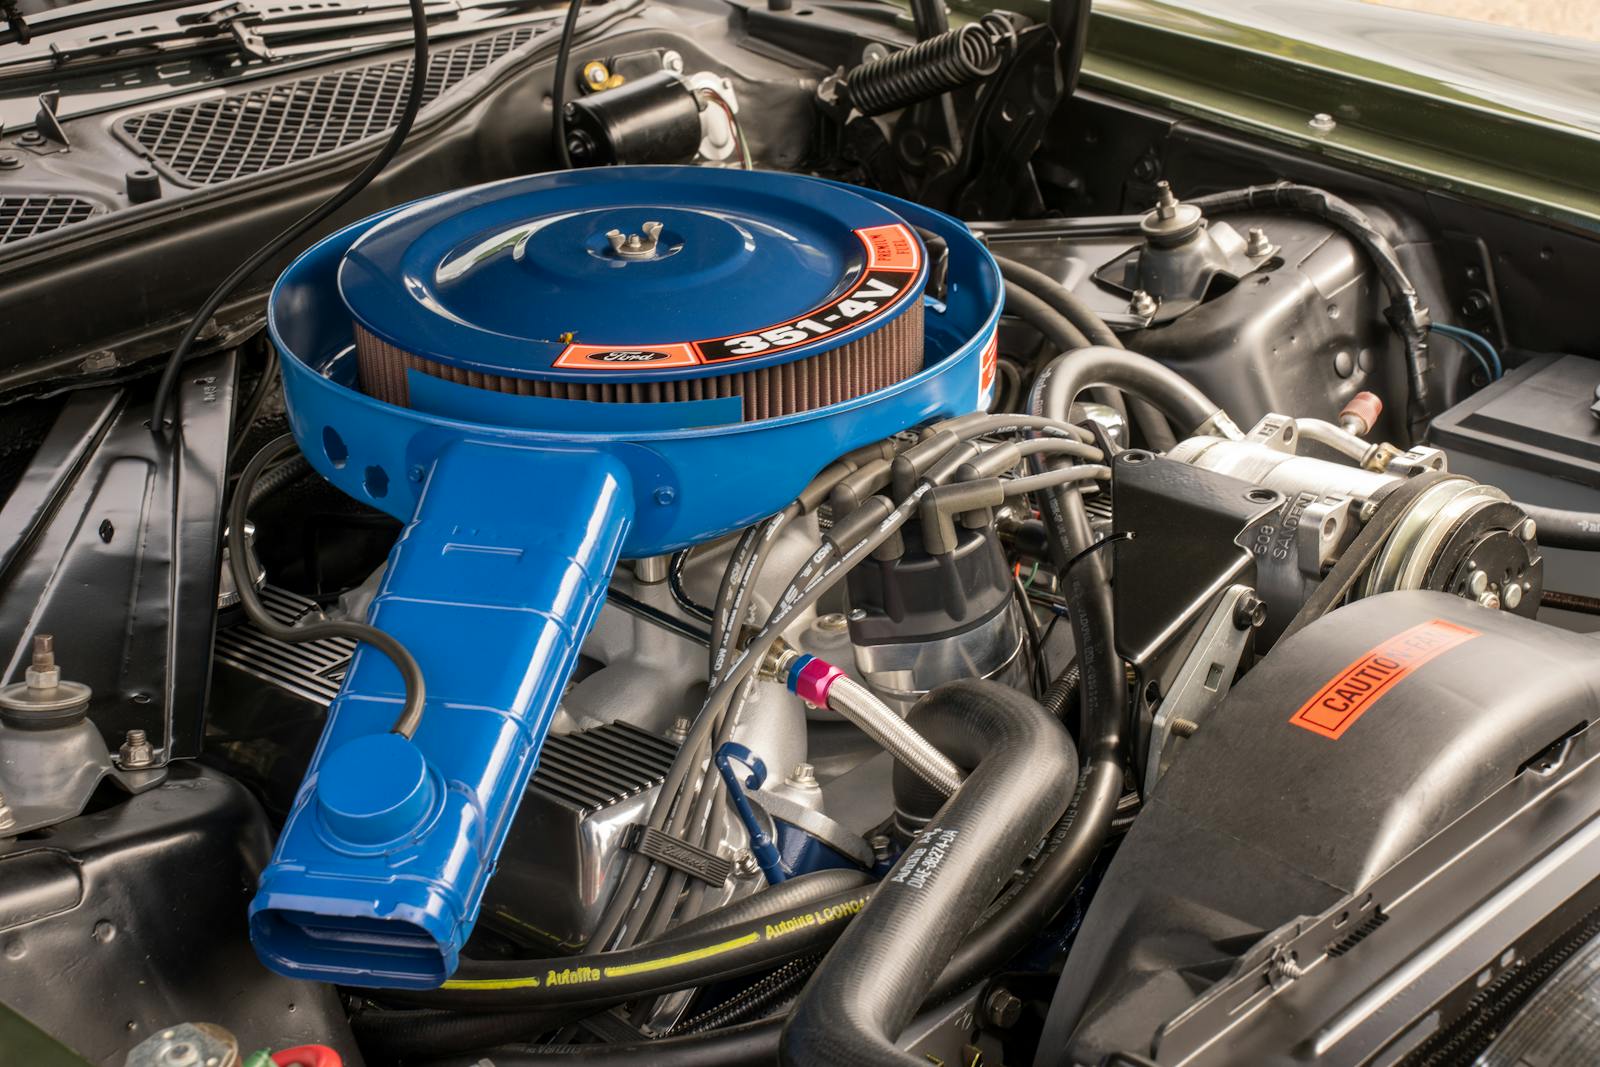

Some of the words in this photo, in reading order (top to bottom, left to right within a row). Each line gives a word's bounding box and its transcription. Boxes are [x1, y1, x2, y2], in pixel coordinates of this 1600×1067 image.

[724, 278, 899, 354] 351-4V
[603, 351, 655, 362] Ford
[1254, 525, 1275, 555] 508
[1274, 496, 1314, 560] SANDEN
[813, 542, 833, 564] MSD
[714, 647, 727, 671] MSD
[545, 967, 601, 987] Autolite
